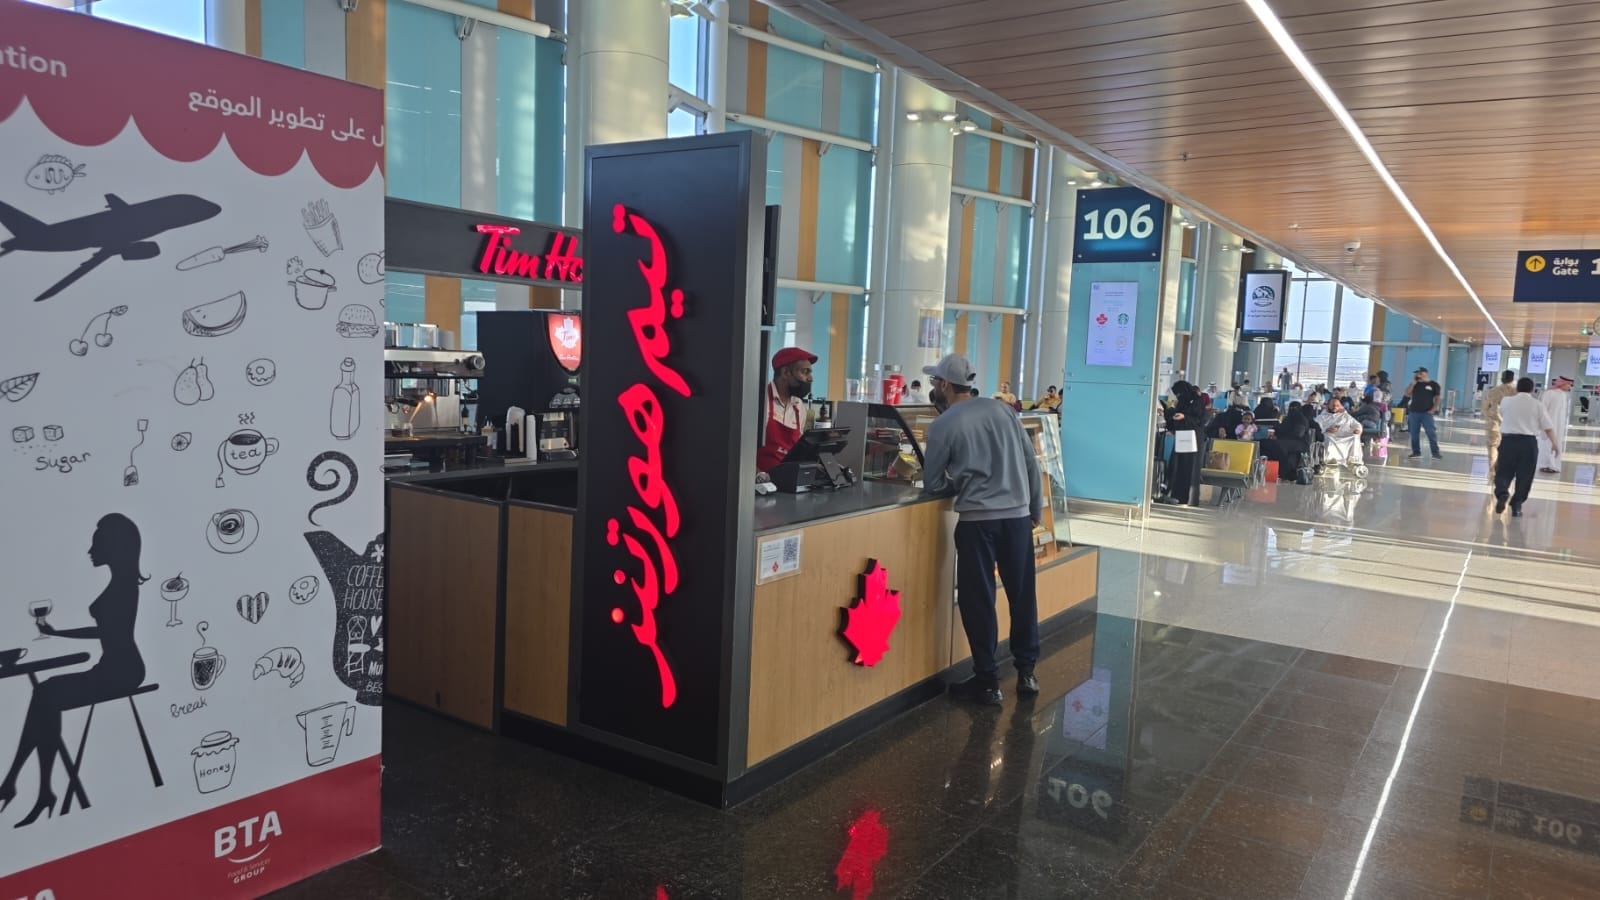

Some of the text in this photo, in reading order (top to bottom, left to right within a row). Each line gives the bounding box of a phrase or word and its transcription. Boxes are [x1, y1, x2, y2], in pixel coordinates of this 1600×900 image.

[0, 46, 67, 78] tion
[188, 89, 261, 118] الموقع
[268, 106, 325, 130] تطوير
[331, 118, 366, 141] على
[1083, 204, 1154, 240] 106
[476, 224, 540, 279] Tim
[1553, 257, 1579, 268] بوابة
[1552, 266, 1580, 276] Gate
[613, 203, 692, 398] تيم
[35, 451, 92, 473] Sugar
[230, 448, 261, 461] tea
[343, 588, 384, 610] HOUSE
[170, 697, 207, 718] Break
[200, 763, 230, 778] Honey
[214, 810, 282, 858] BTA
[233, 866, 265, 884] GROUP
